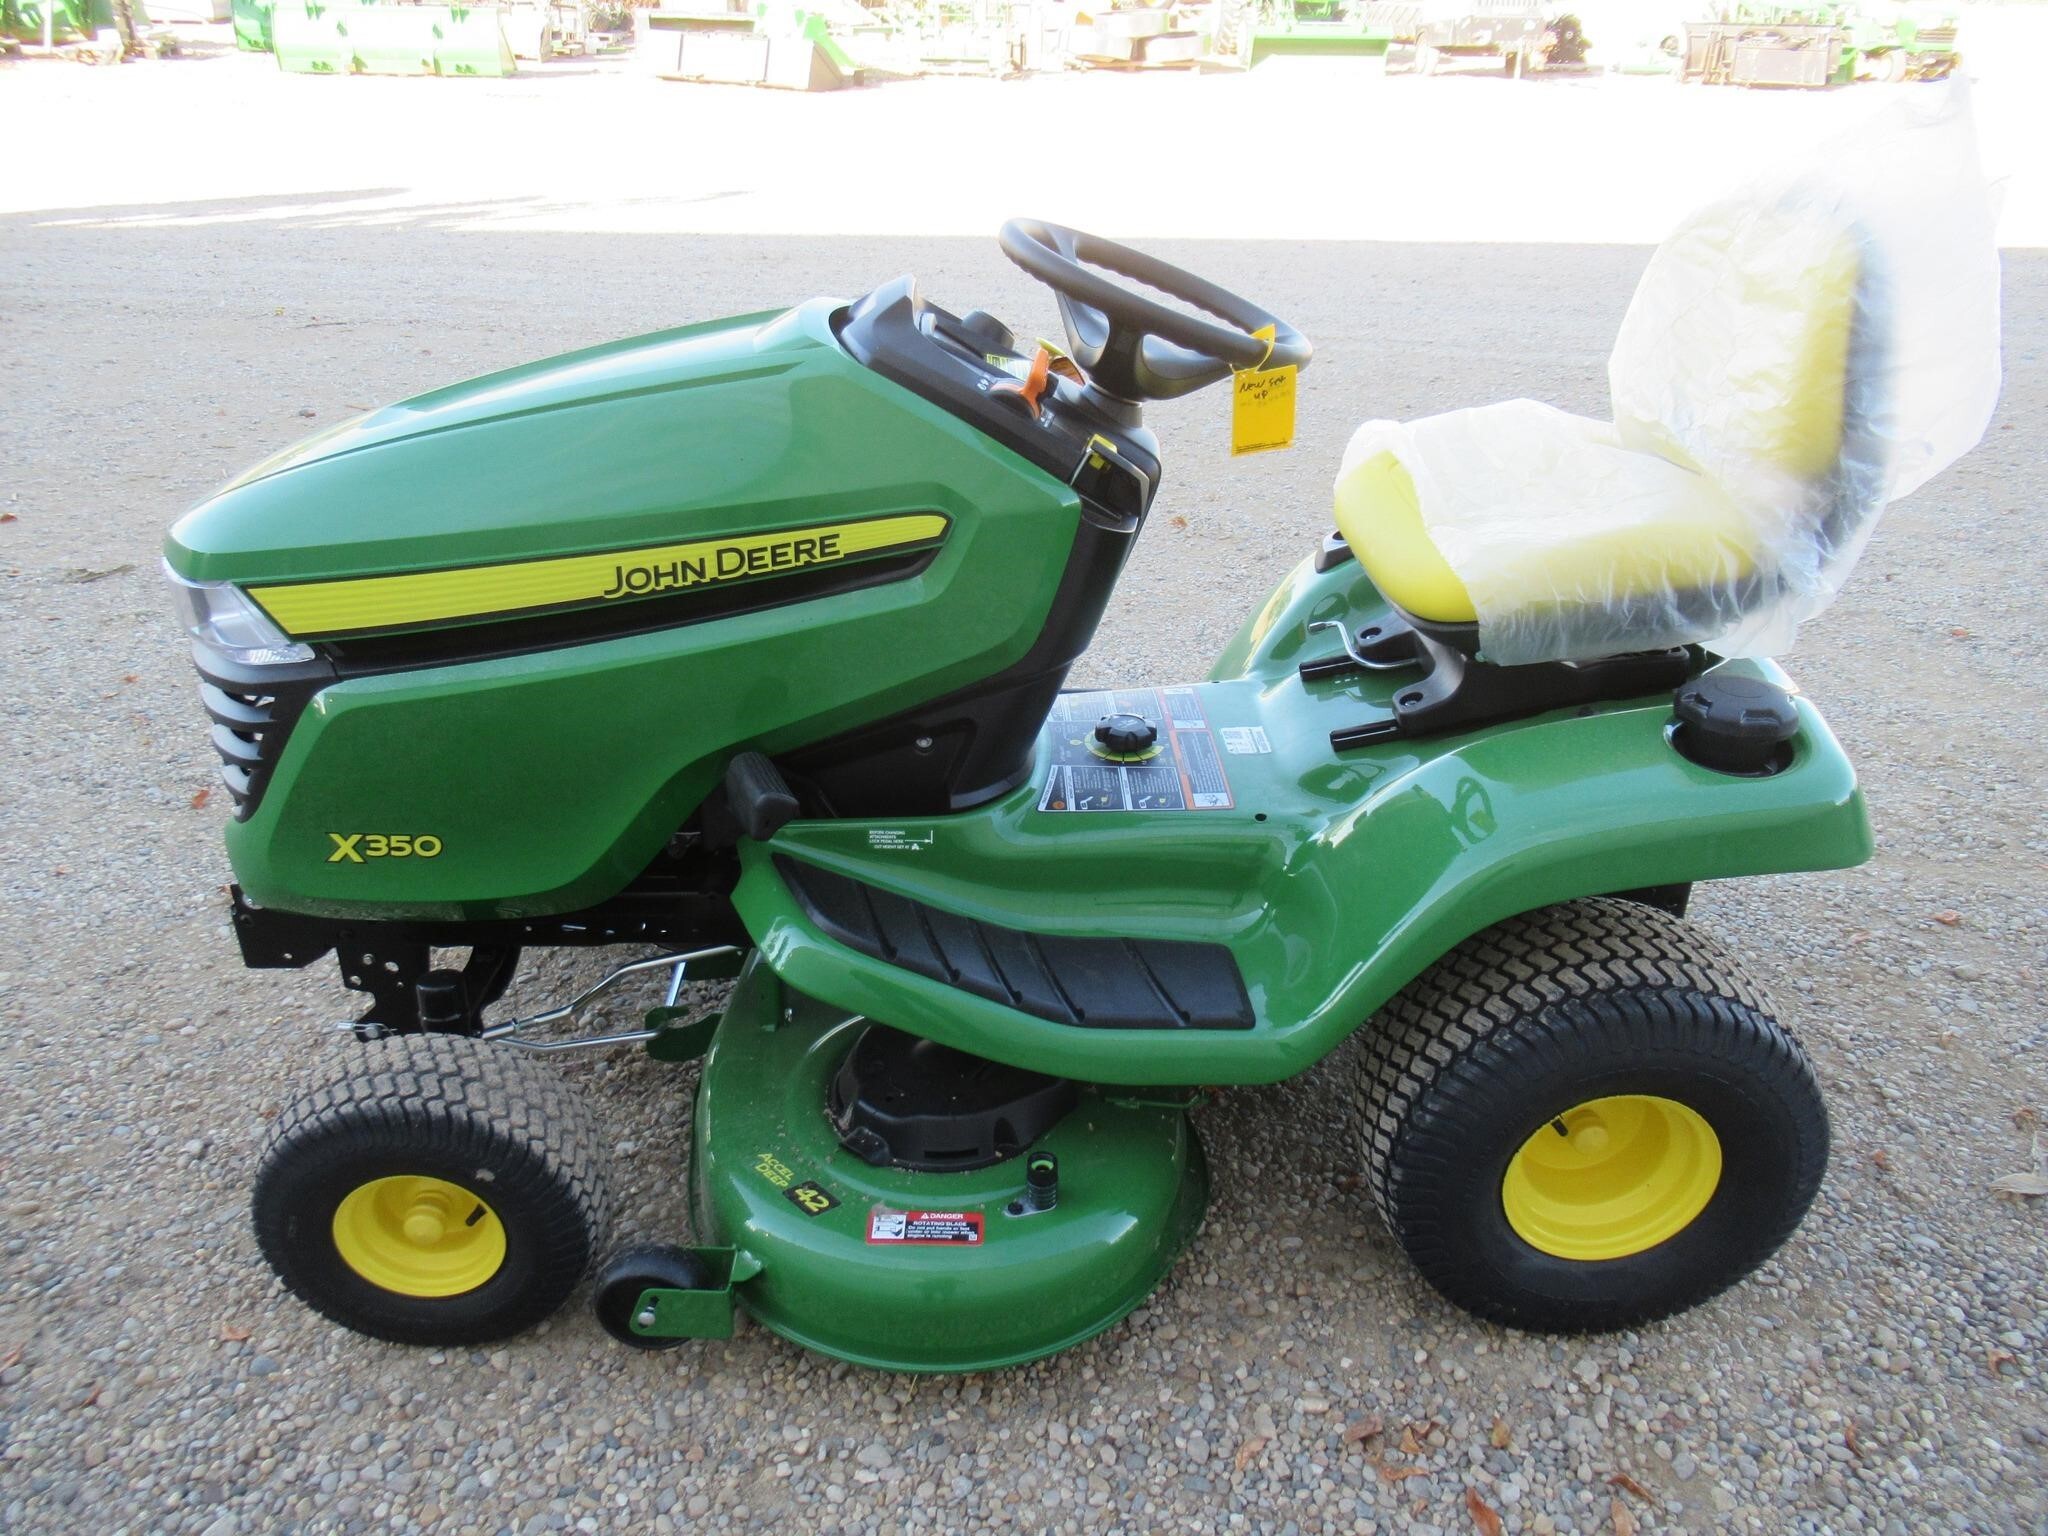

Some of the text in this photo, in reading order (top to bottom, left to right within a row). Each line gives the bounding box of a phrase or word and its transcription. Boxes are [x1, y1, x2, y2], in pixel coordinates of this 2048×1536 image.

[603, 533, 841, 596] JOHN DEERE
[326, 832, 443, 863] X350
[755, 1163, 789, 1187] DEEP
[757, 1153, 794, 1180] ACCEL
[794, 1188, 830, 1212] 42
